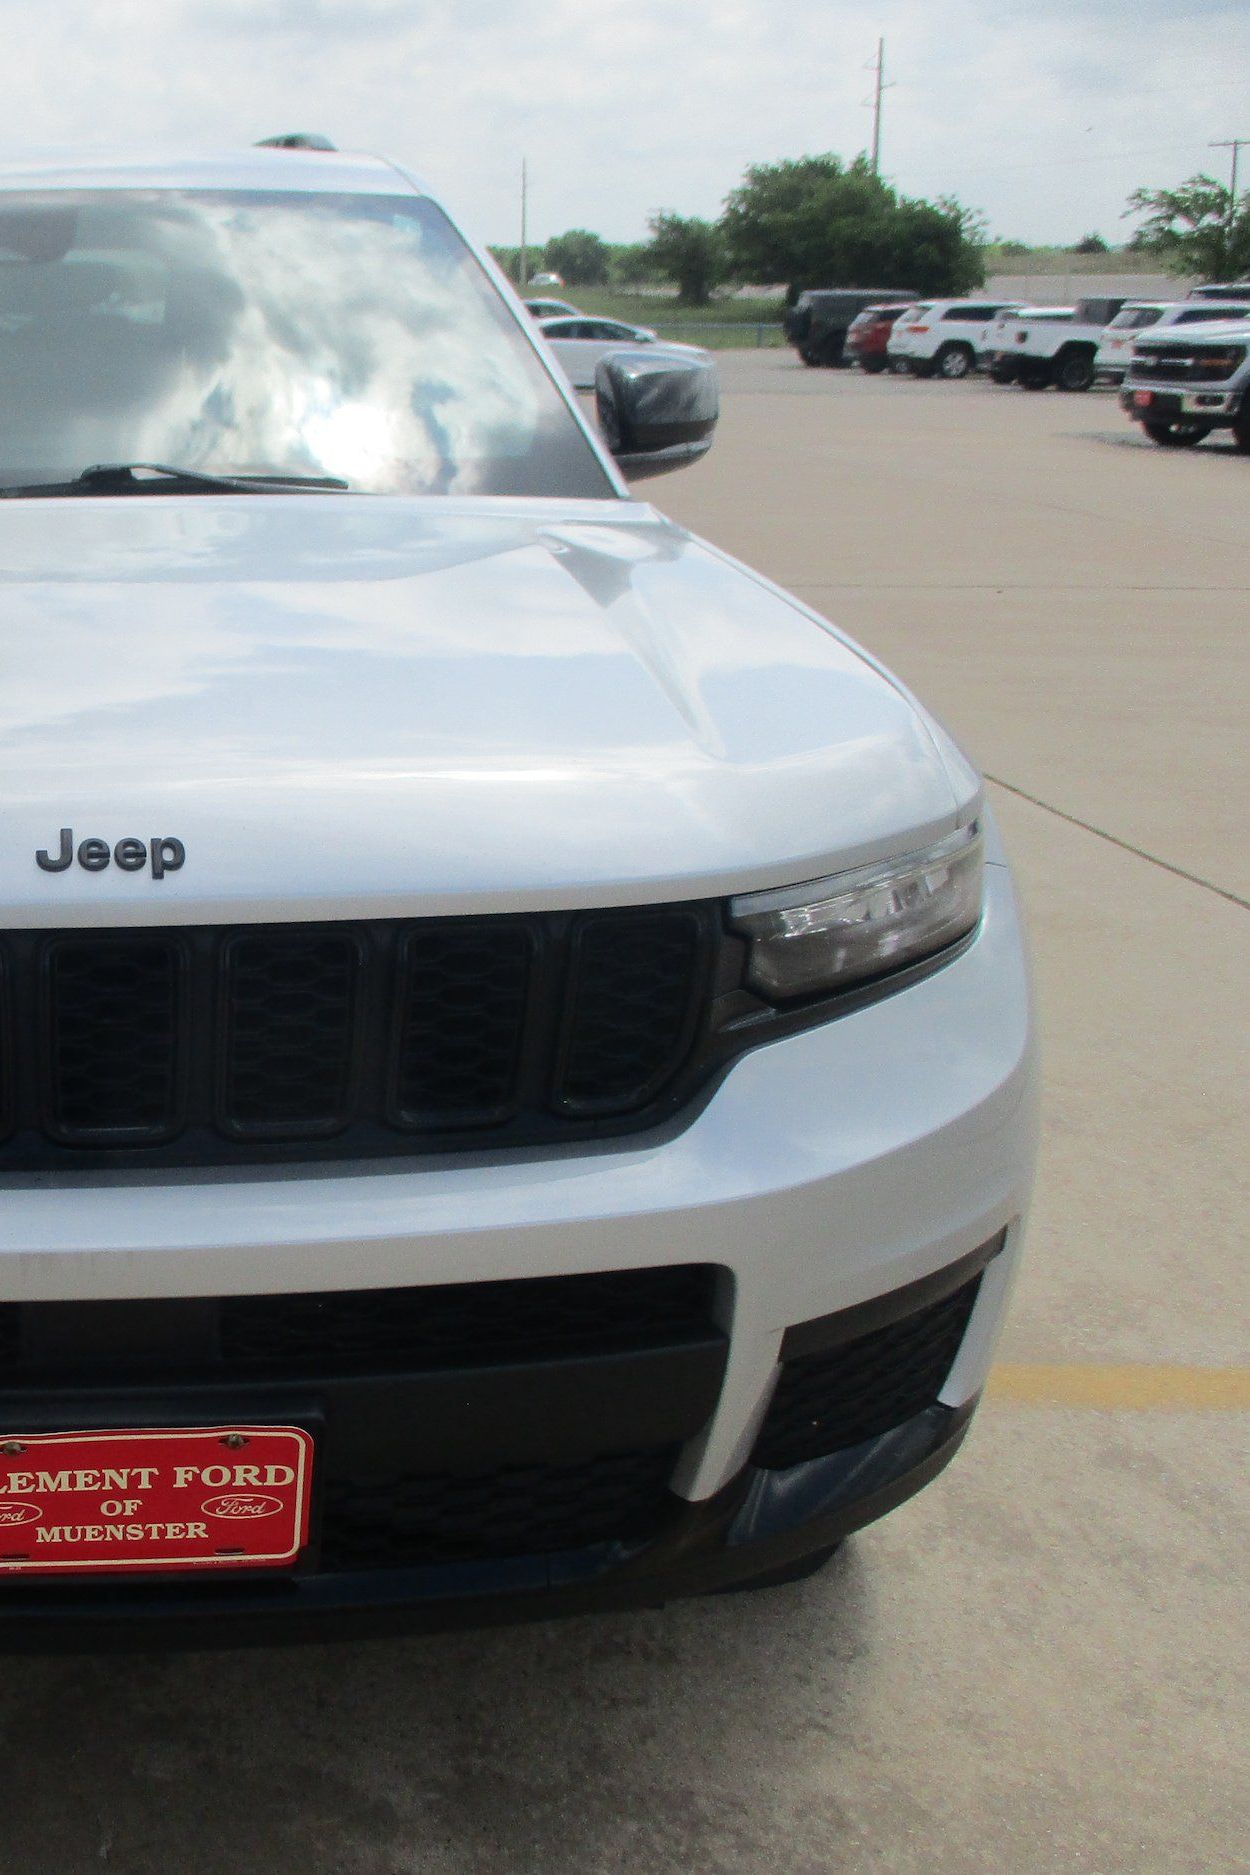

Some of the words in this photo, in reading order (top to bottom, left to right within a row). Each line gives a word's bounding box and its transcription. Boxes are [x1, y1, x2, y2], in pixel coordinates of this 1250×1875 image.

[35, 828, 186, 880] Jeep
[173, 1464, 295, 1488] FORD
[100, 1499, 143, 1517] OF
[215, 1498, 267, 1515] Ford
[35, 1521, 209, 1543] MUENSTER
